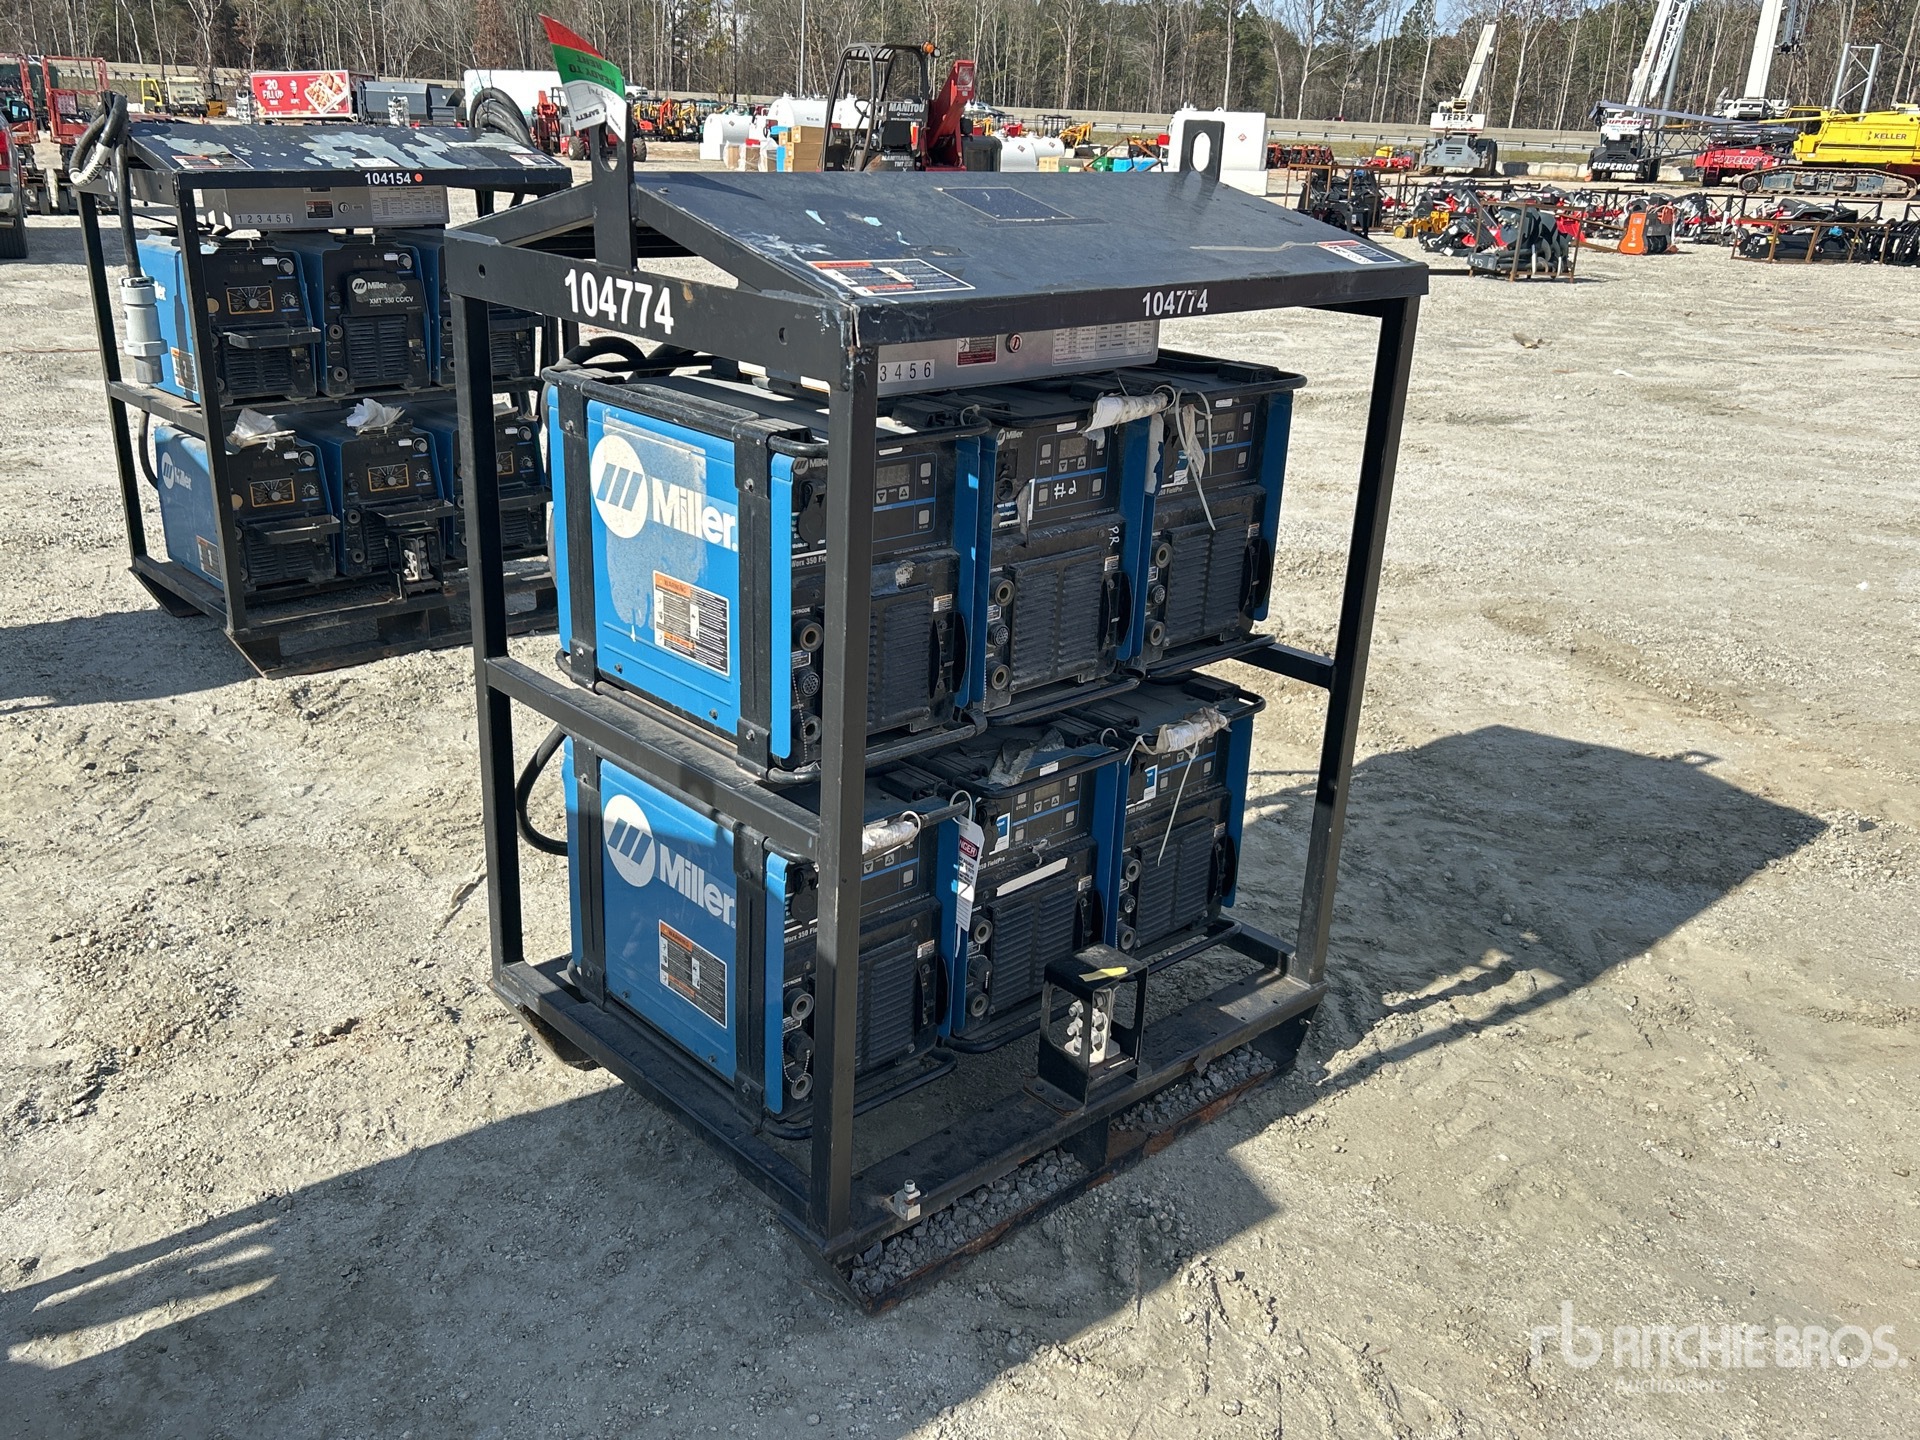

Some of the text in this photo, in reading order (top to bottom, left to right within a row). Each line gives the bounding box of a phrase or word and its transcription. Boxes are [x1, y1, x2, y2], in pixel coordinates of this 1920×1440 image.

[889, 102, 925, 113] MANITOU
[575, 108, 600, 122] SAFETY
[1442, 114, 1474, 122] TEREX
[1874, 132, 1907, 140] KELLER
[1591, 162, 1640, 171] SUPERIOR
[364, 172, 412, 185] 104154
[367, 281, 387, 290] Miller
[369, 297, 382, 305] XMT
[564, 268, 674, 335] 104774
[1142, 289, 1208, 317] 104774
[1006, 430, 1024, 440] Miller
[806, 556, 817, 565] 350
[798, 931, 809, 941] 350
